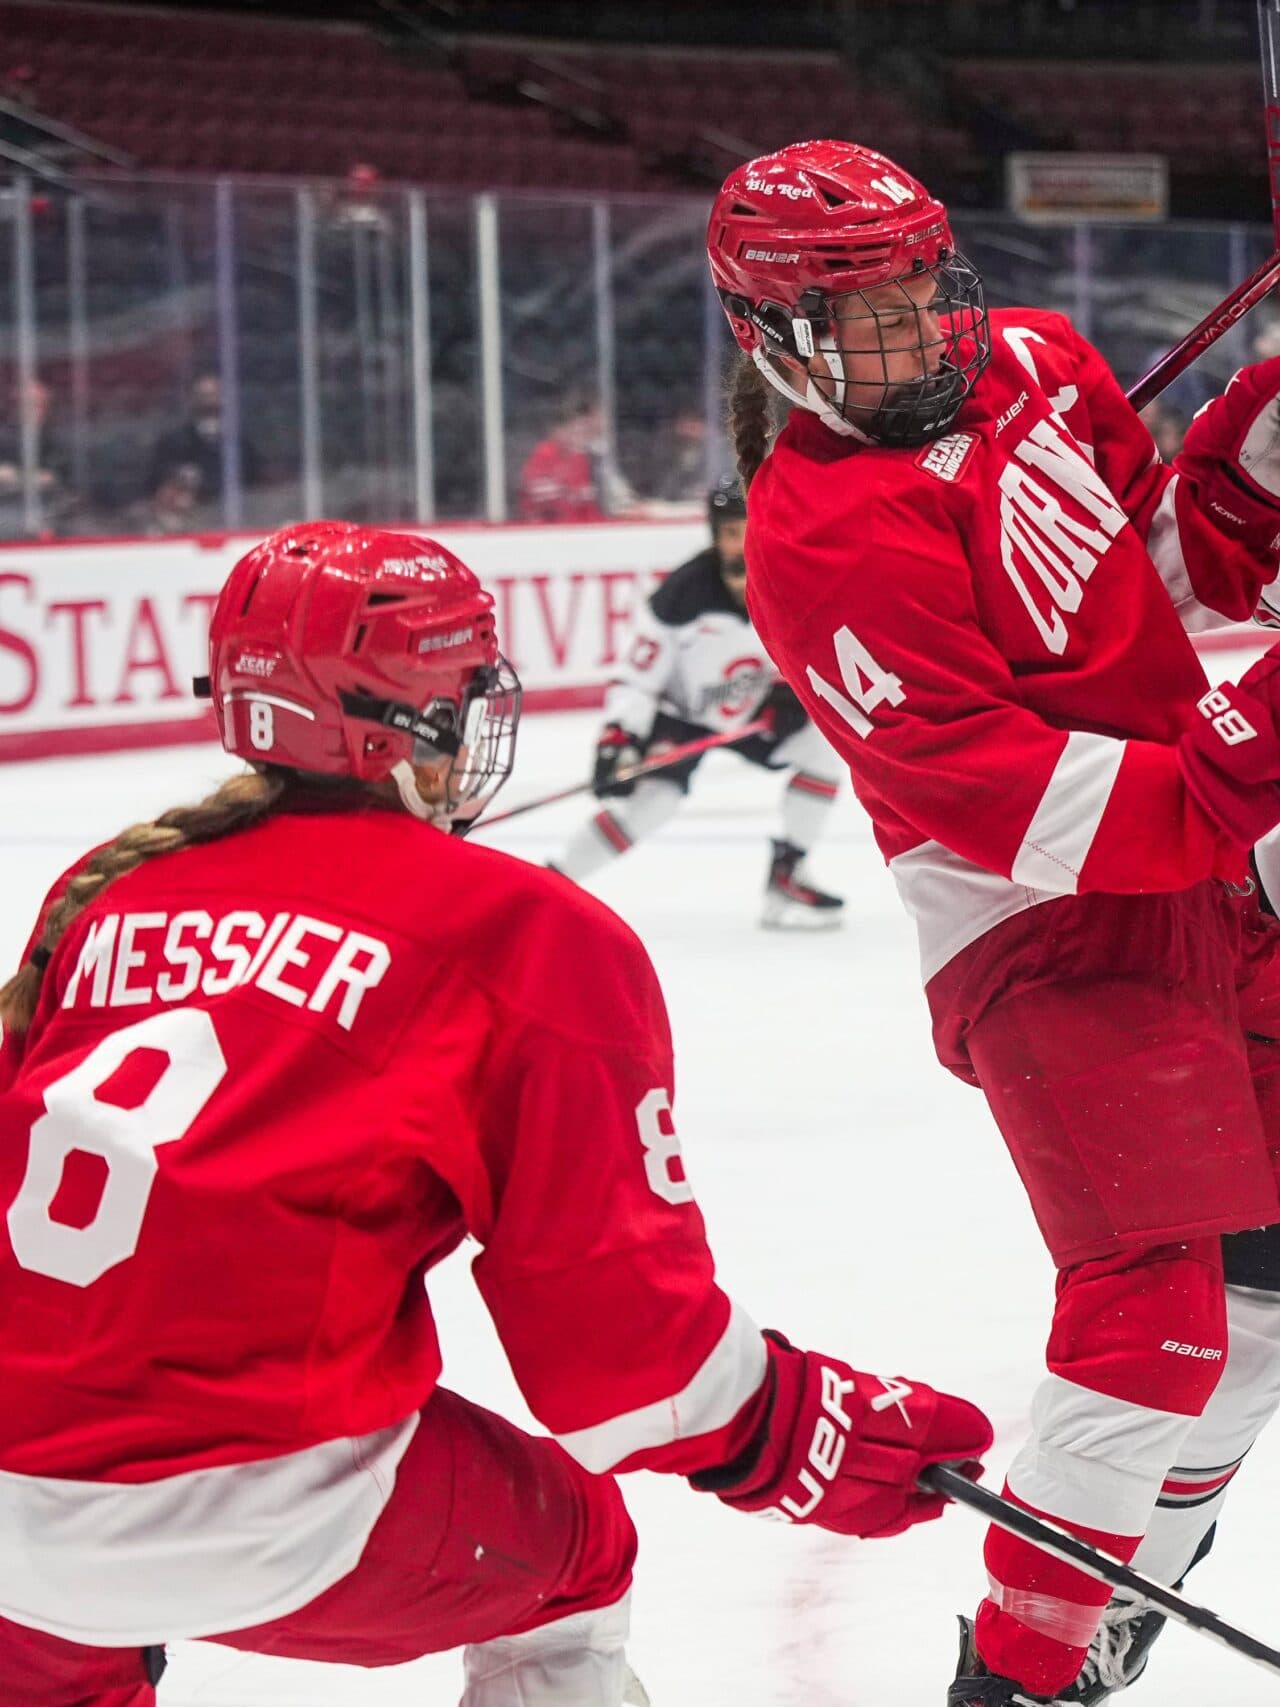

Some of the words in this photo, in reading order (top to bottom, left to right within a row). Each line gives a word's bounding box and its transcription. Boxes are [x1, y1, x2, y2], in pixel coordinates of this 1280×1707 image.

[745, 178, 775, 194] Big
[777, 183, 814, 200] Red
[745, 249, 800, 265] BAUER
[752, 314, 784, 343] AUER
[806, 625, 907, 740] 14
[250, 701, 273, 751] 8
[61, 909, 391, 1031] MESSIER
[7, 1007, 227, 1288] 8
[635, 1087, 696, 1206] 8
[1161, 1340, 1222, 1360] BAUER
